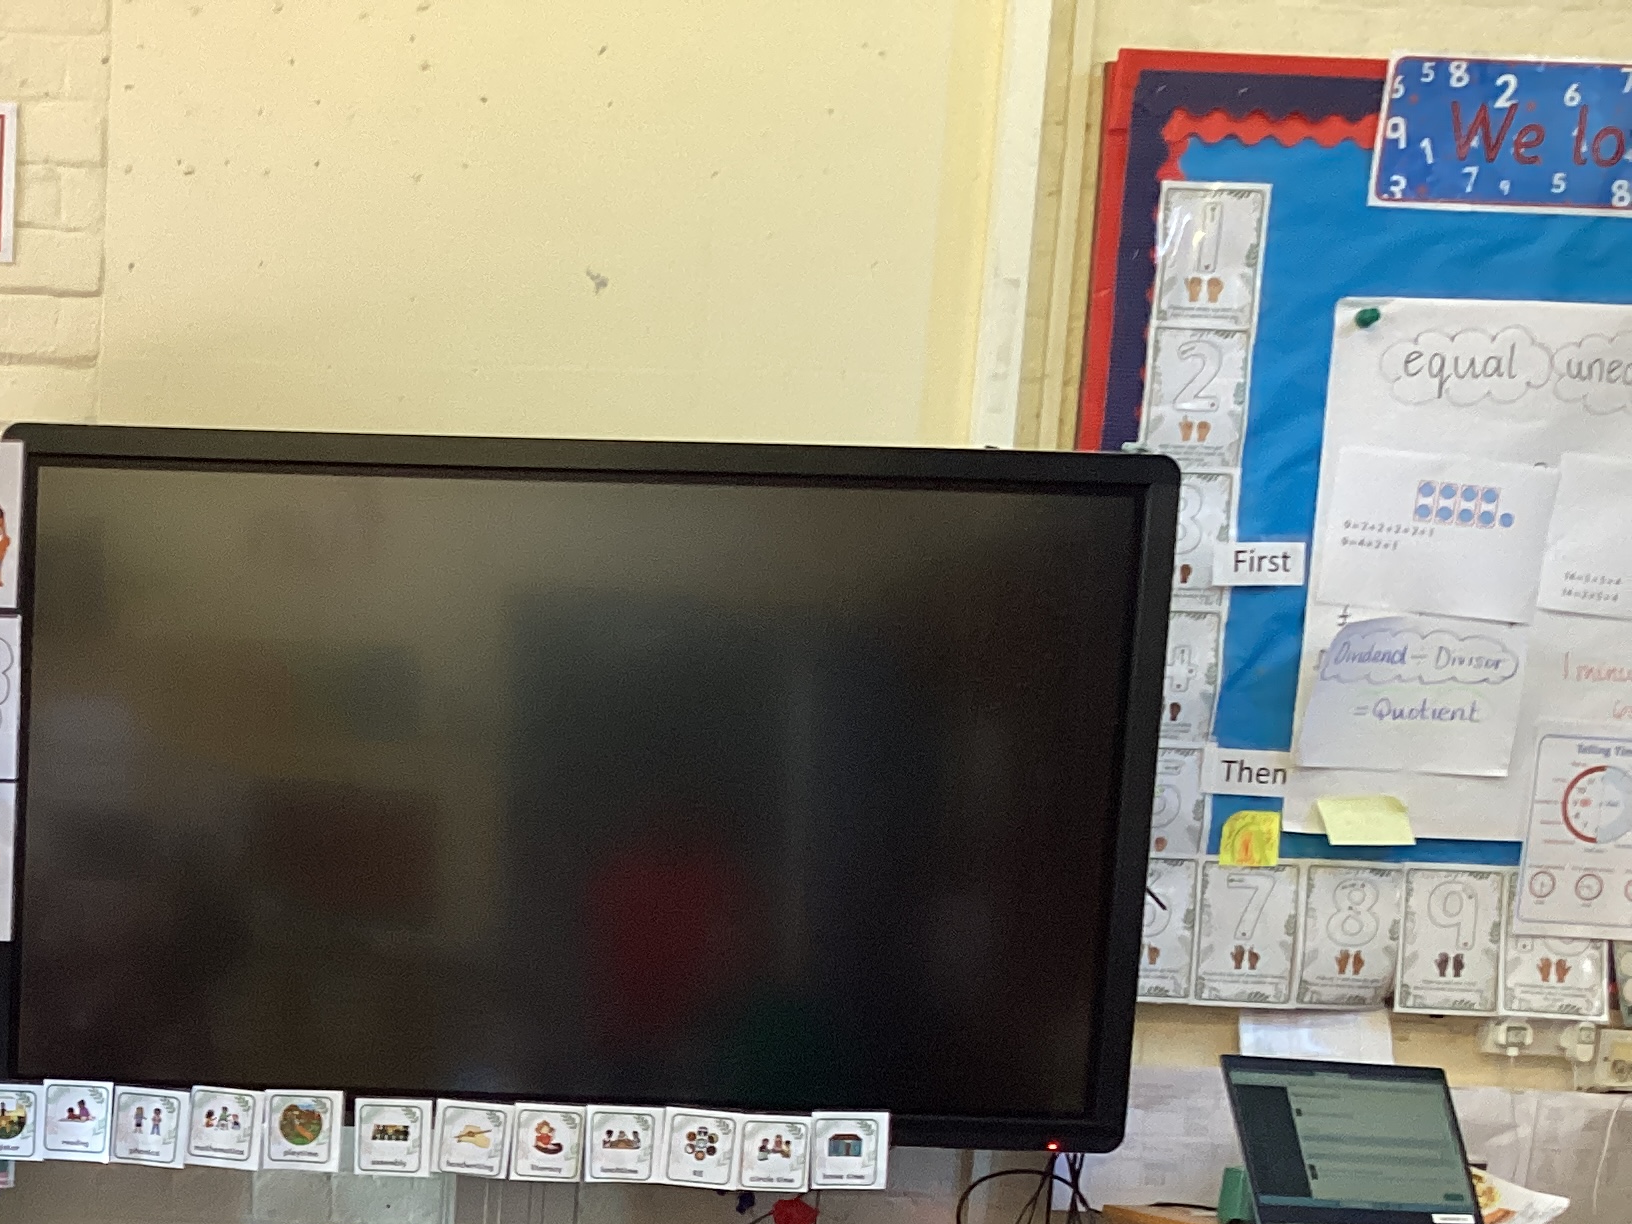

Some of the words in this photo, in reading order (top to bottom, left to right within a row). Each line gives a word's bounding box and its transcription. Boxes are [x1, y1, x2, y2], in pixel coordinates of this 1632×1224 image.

[1420, 62, 1435, 83] 5
[1449, 61, 1470, 88] 8
[1493, 74, 1519, 108] 2
[1563, 82, 1582, 107] 6
[1386, 116, 1407, 149] 9
[1451, 101, 1545, 165] We
[1420, 137, 1434, 165] 1
[1461, 166, 1479, 194] 7
[1551, 172, 1567, 194] 5
[1611, 179, 1631, 208] 8
[1174, 340, 1224, 411] 2
[1403, 342, 1519, 398] equal
[1233, 548, 1291, 573] First
[1434, 645, 1504, 671] Divisor
[1372, 697, 1481, 723] Quotient
[1221, 759, 1288, 785] Then
[1227, 873, 1277, 941] 7
[1326, 878, 1379, 946] 8
[1428, 880, 1478, 951] 9
